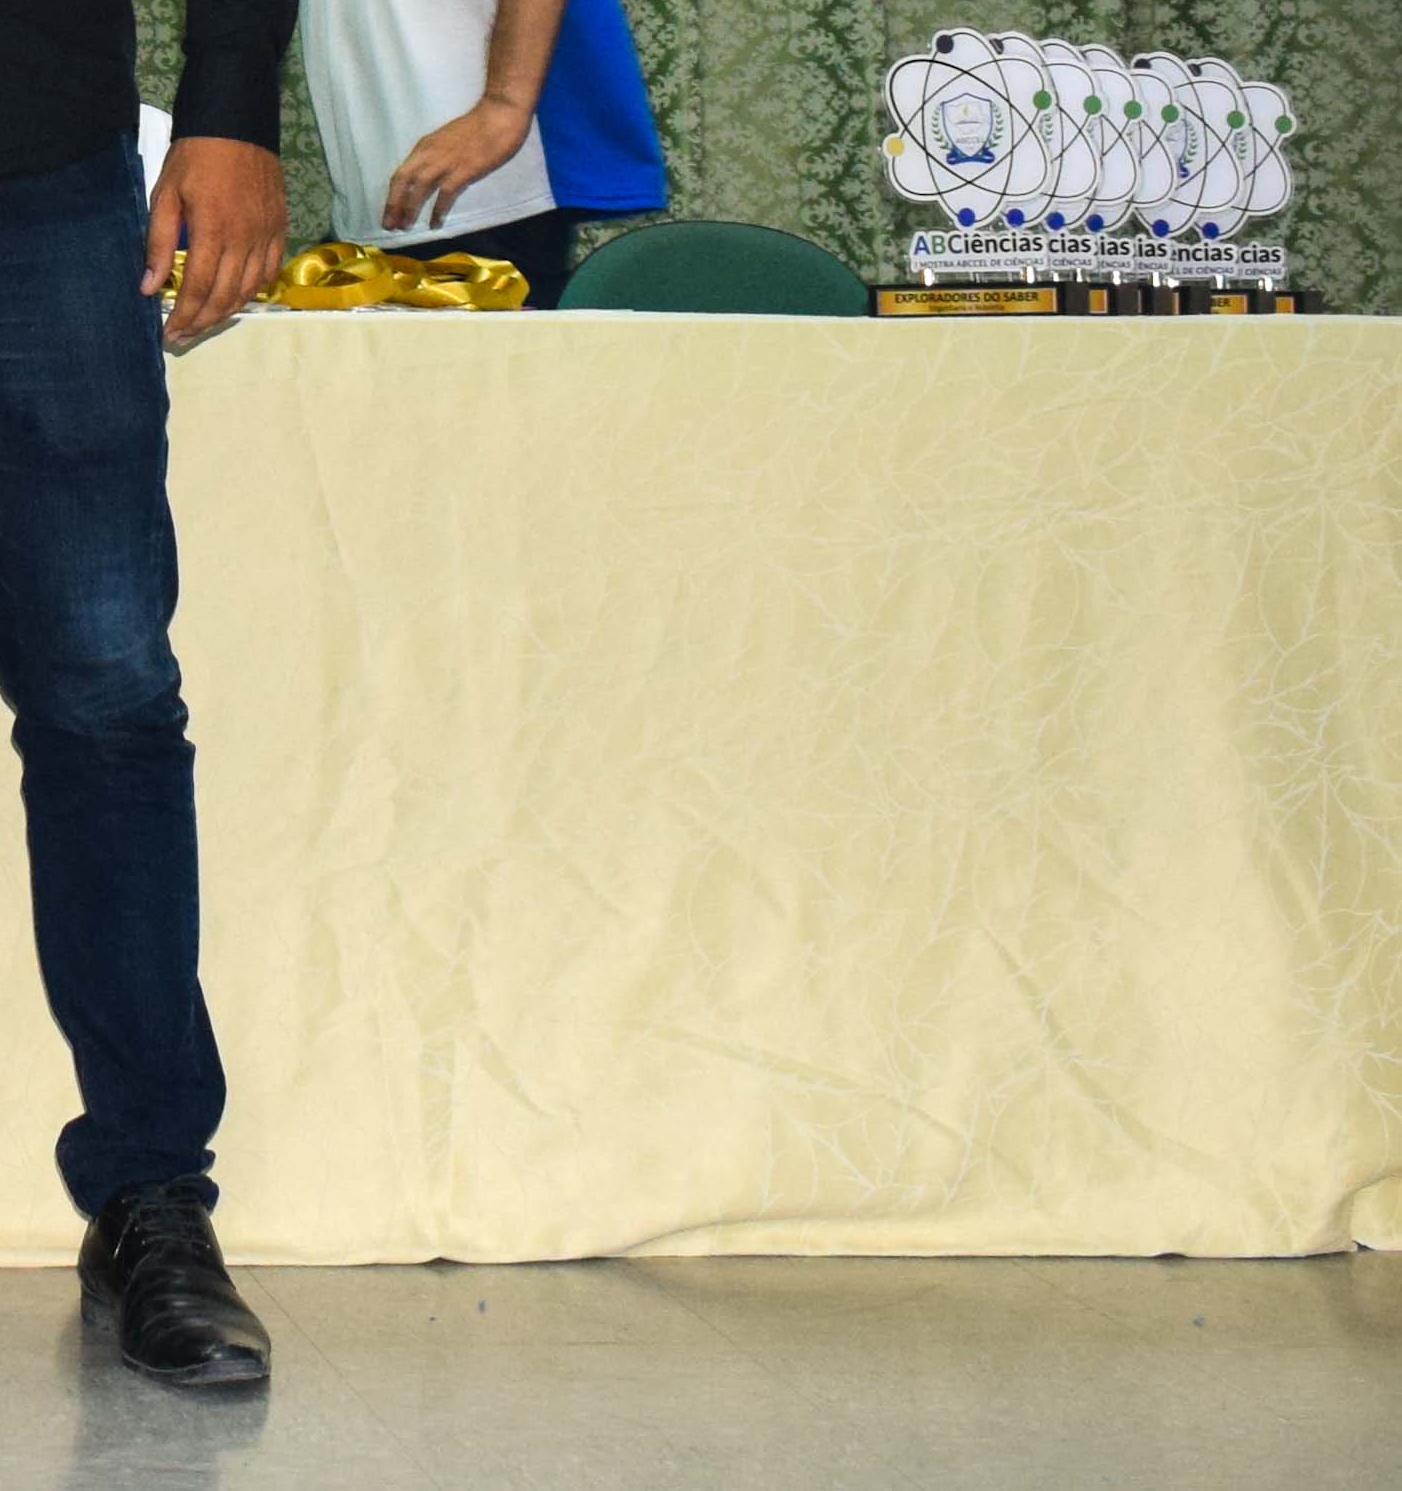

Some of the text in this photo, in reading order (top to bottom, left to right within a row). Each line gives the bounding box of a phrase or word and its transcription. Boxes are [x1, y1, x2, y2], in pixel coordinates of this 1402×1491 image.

[913, 231, 1043, 256] ABCiências
[1094, 235, 1131, 256] ias
[1134, 237, 1167, 258] ias
[895, 291, 1039, 304] EXPLORADORES DO SABER
